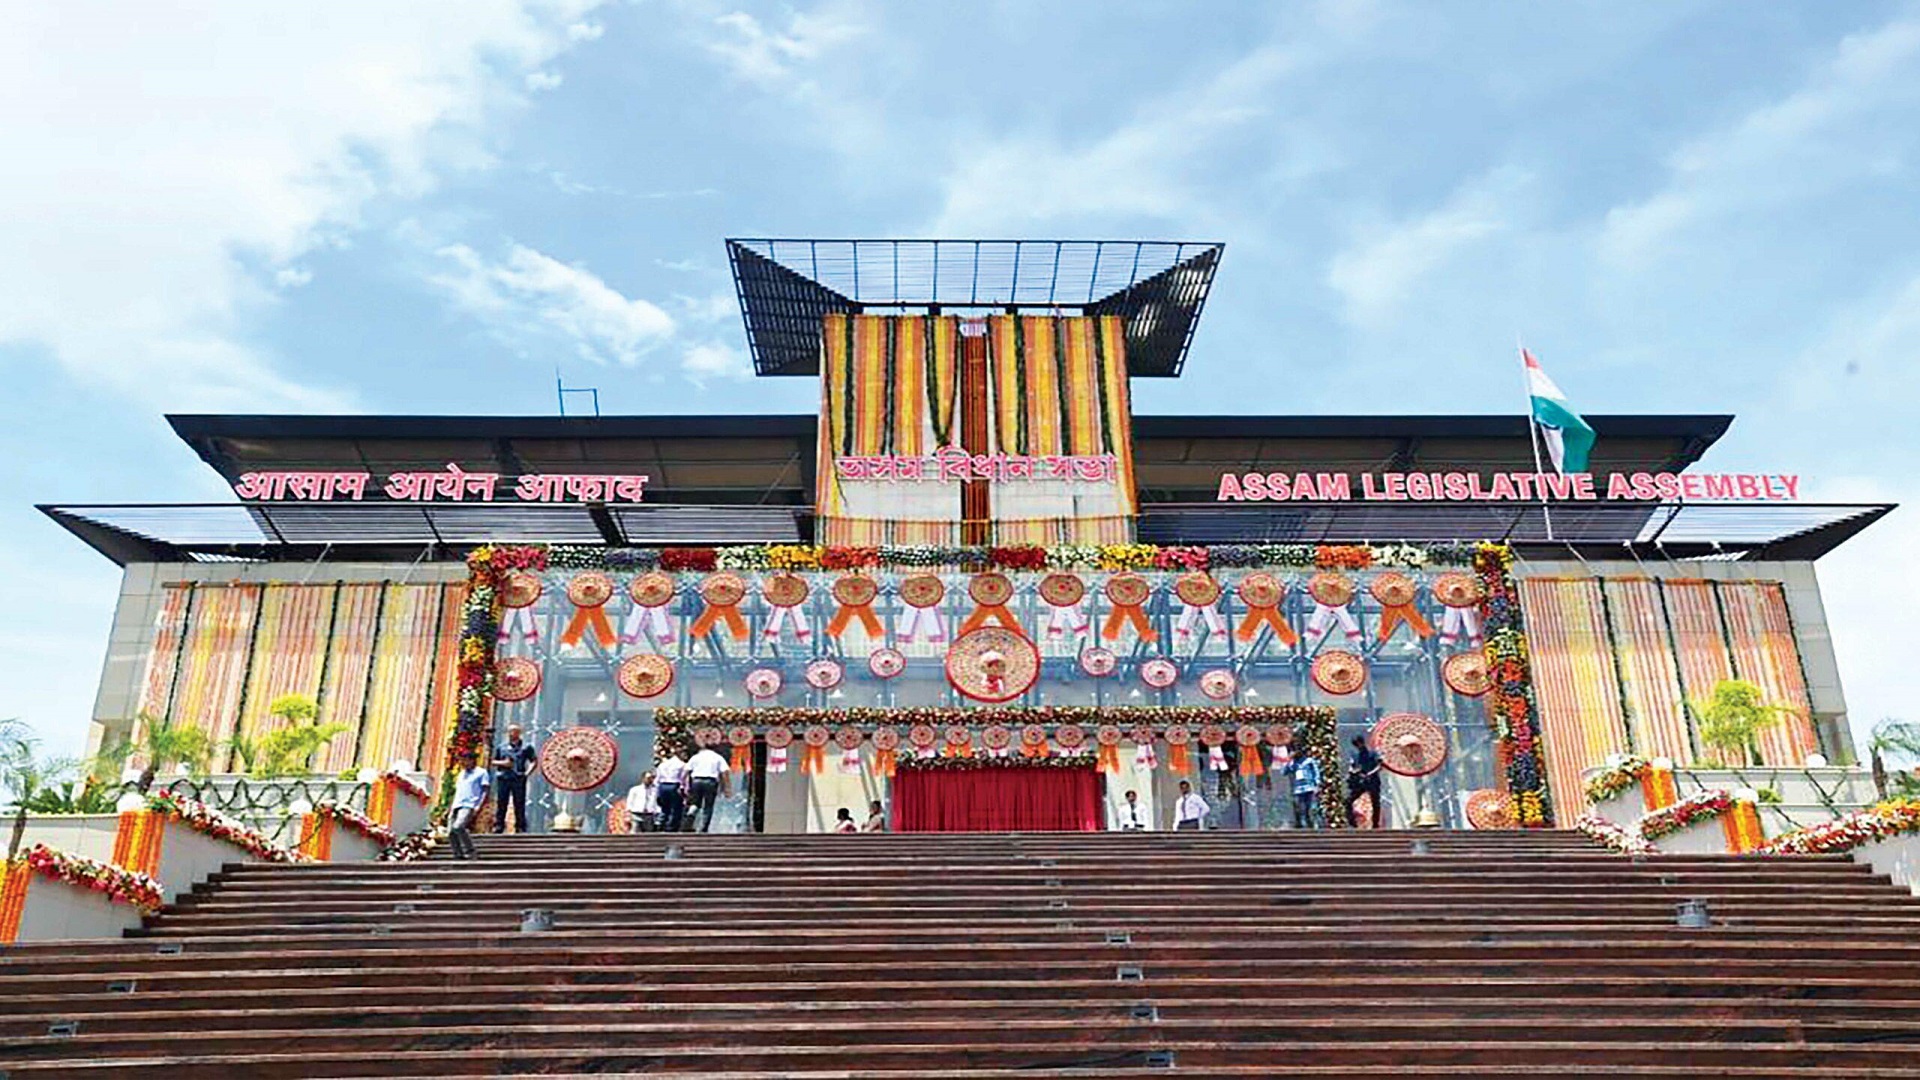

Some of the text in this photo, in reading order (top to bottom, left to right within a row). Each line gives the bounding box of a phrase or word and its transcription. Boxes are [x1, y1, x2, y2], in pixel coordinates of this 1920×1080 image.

[235, 462, 649, 502] आसाम आयेन आफाद
[835, 442, 1118, 484] অসম বিধান সভা
[1217, 472, 1799, 500] ASSAM LEGISLATIVE ASSEMBLY
